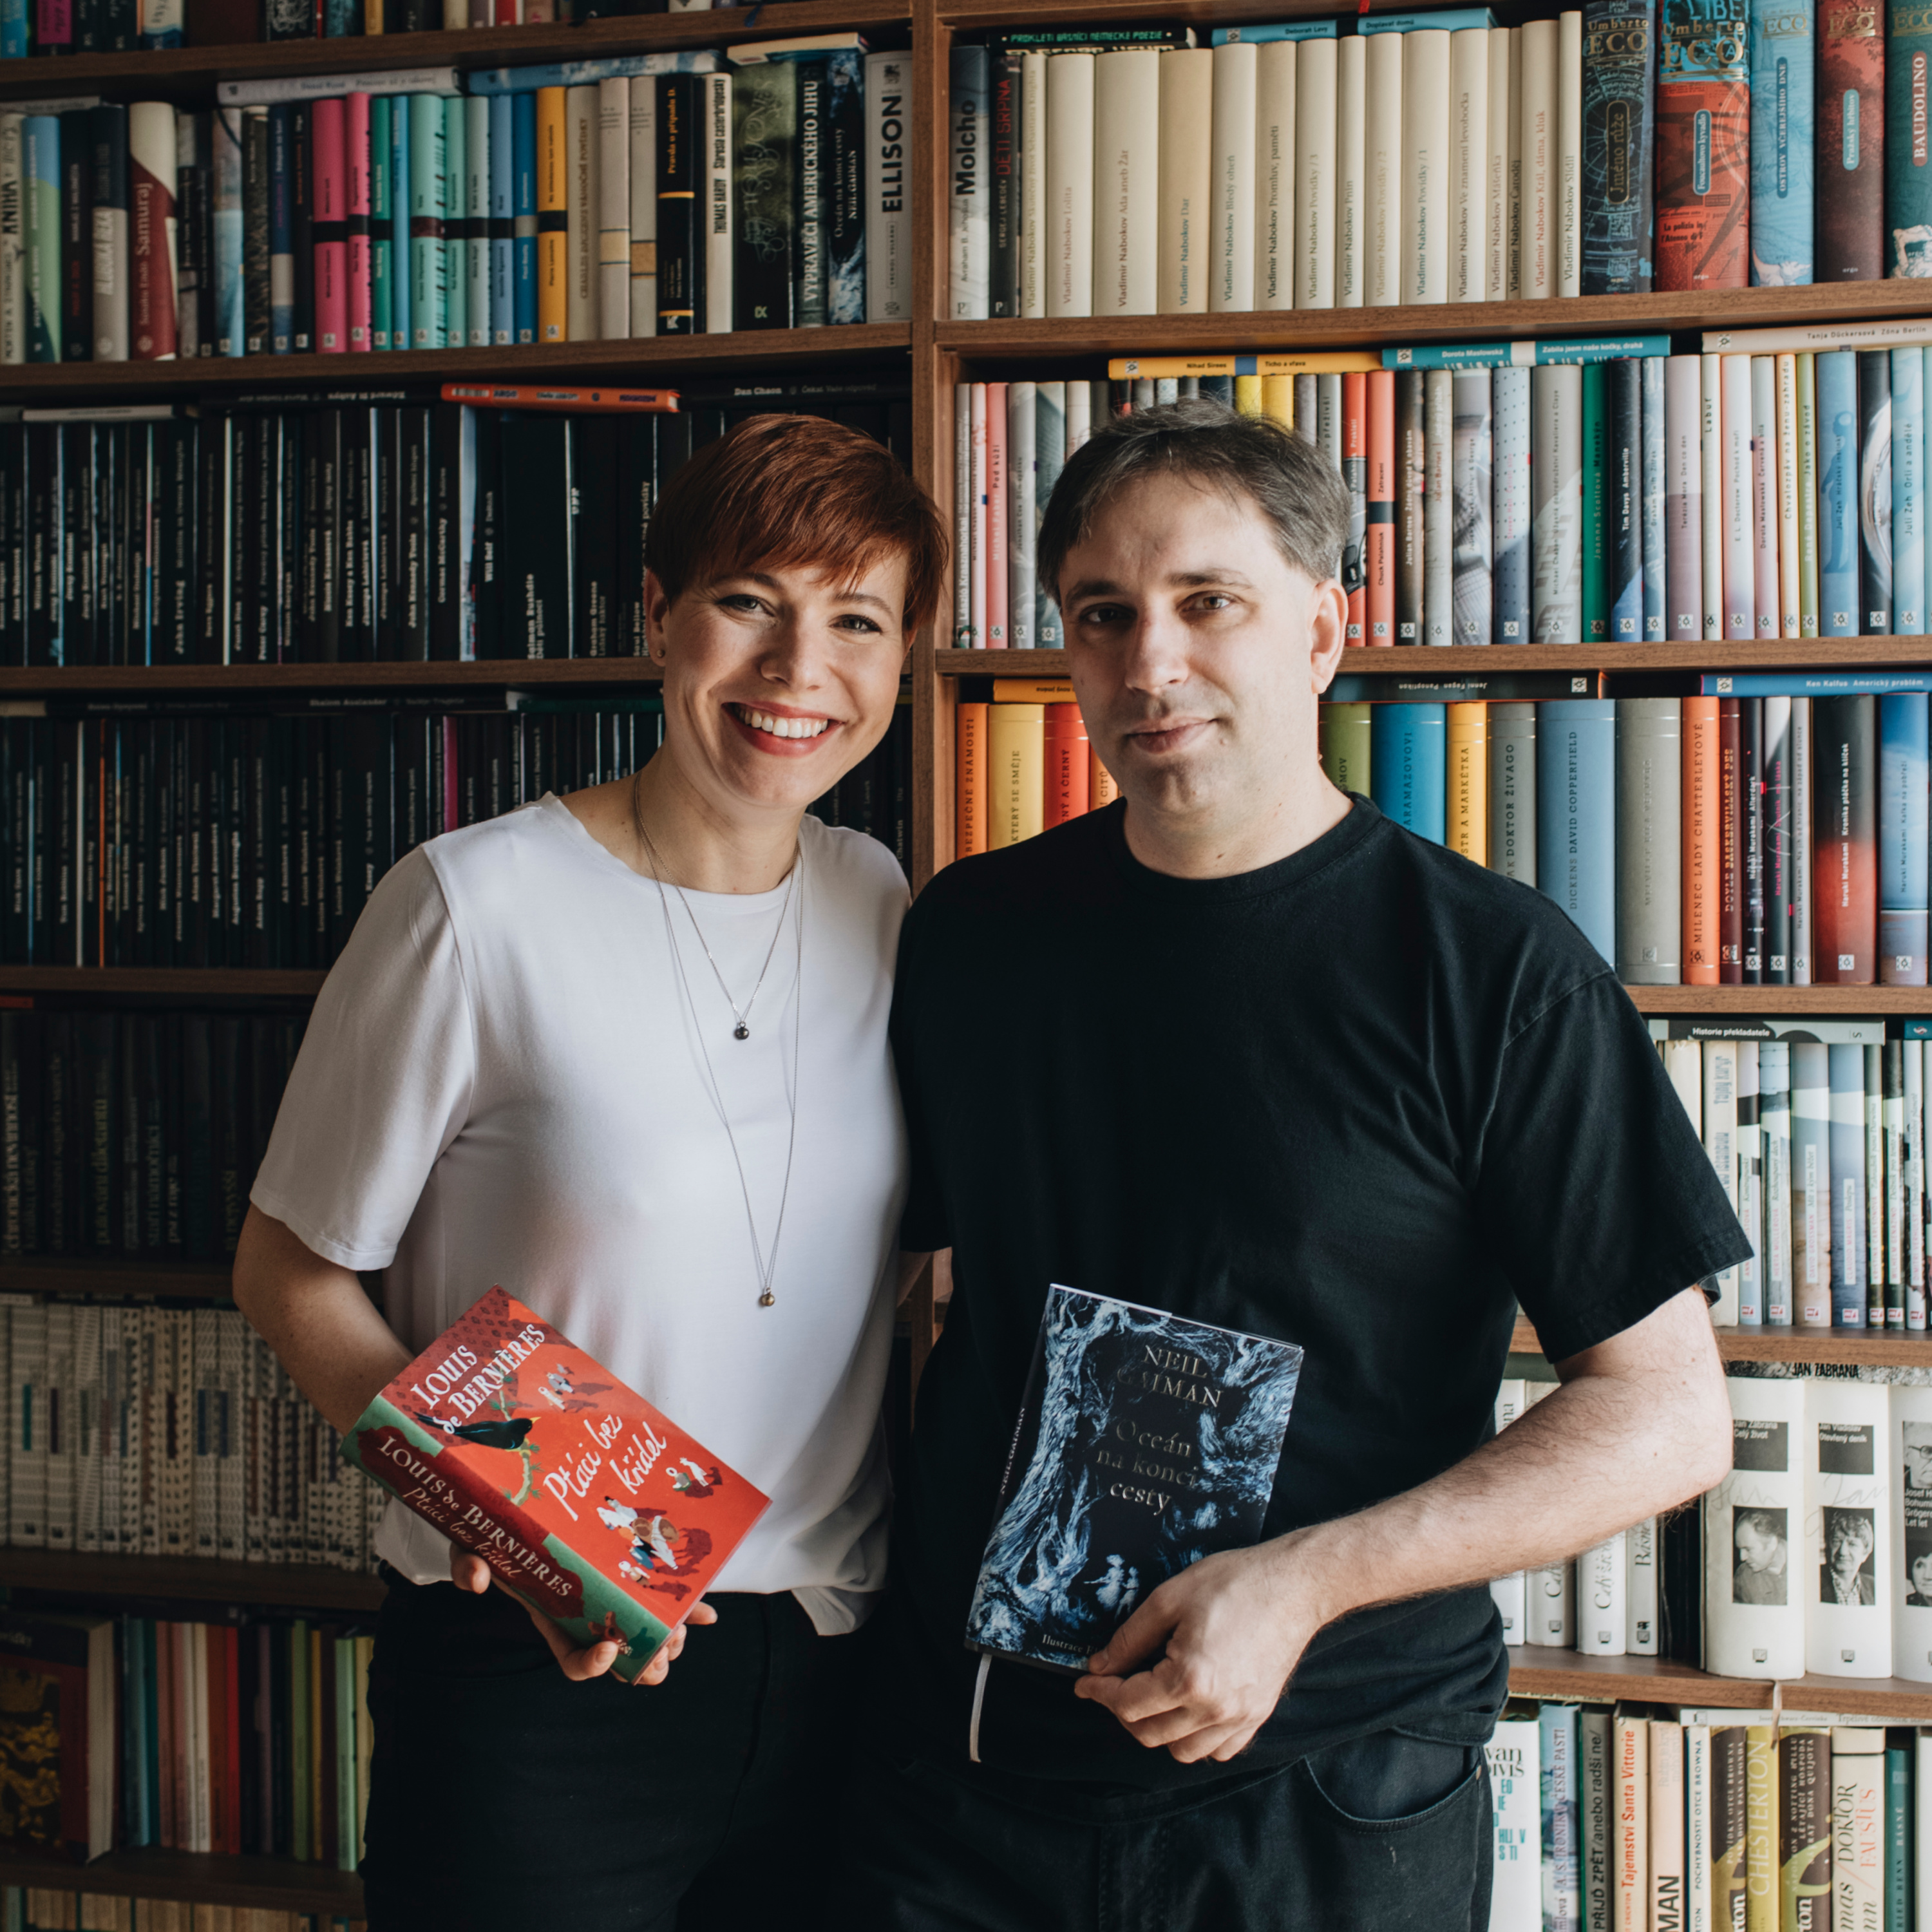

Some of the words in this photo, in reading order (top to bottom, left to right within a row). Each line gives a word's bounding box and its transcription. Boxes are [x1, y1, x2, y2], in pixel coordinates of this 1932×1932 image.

[1588, 18, 1649, 32] Umberto
[1663, 20, 1745, 36] Umberto
[1763, 16, 1807, 32] ECO
[1829, 14, 1874, 31] ECO
[1587, 31, 1647, 55] ECO
[1663, 37, 1744, 68] ECO
[1779, 64, 1787, 84] DNE
[667, 99, 678, 133] případu
[804, 80, 818, 116] JIHU
[997, 79, 1010, 133] SRPNA
[1846, 94, 1855, 126] hřbitov
[1913, 56, 1925, 158] BAUDOLINO
[1535, 110, 1545, 133] kluk
[1610, 113, 1625, 142] růže
[1698, 114, 1709, 143] kyvadlo
[1777, 88, 1787, 148] VČEREJŠÍHO
[835, 129, 845, 154] cesty
[882, 95, 902, 213] ELLISON
[956, 99, 976, 195] Molcho
[996, 140, 1010, 175] DĚTI
[1117, 149, 1129, 165] Žár
[1269, 126, 1281, 159] paměti
[1846, 128, 1855, 164] Pražský
[801, 119, 818, 218] AMERICKÉHO
[834, 158, 843, 185] konci
[848, 150, 857, 192] GAIMAN
[1119, 169, 1128, 192] aneb
[1226, 155, 1236, 180] oheň
[1459, 146, 1469, 189] znamení
[1610, 147, 1625, 193] Jméno
[1698, 144, 1706, 189] Foucaultovo
[1779, 154, 1787, 191] OSTROV
[714, 178, 726, 202] HARDY
[837, 189, 843, 200] na
[848, 194, 857, 219] NEIL
[1063, 187, 1072, 214] Lolita
[1120, 196, 1129, 214] Ada
[1180, 198, 1189, 215] Dar
[1226, 184, 1236, 209] Bledý
[1459, 193, 1468, 204] Ve
[135, 183, 153, 256] Samuraj
[714, 204, 726, 234] THOMAS
[834, 204, 843, 238] Oceán
[1225, 213, 1234, 256] Nabokov
[1268, 210, 1278, 253] Nabokov
[1345, 207, 1354, 251] Nabokov
[1459, 207, 1468, 251] Nabokov
[1535, 196, 1545, 241] Nabokov
[1063, 218, 1072, 260] Nabokov
[1119, 218, 1128, 261] Nabokov
[1180, 220, 1189, 261] Nabokov
[801, 222, 818, 301] VYPRAVĚČI
[1268, 257, 1278, 298] Vladimir
[1345, 254, 1354, 296] Vladimir
[1459, 255, 1468, 296] Vladimir
[1535, 244, 1545, 287] Vladimir
[1063, 263, 1072, 303] Vladimir
[1118, 265, 1128, 307] Vladimir
[1180, 265, 1189, 305] Vladimir
[1225, 260, 1234, 301] Vladimir
[1904, 469, 1913, 488] Orli
[1904, 496, 1913, 513] Zeh
[1904, 517, 1913, 535] Juli
[1853, 679, 1889, 687] Americký
[1891, 678, 1923, 687] problém
[965, 719, 974, 782] ZNÁMOSTI
[1010, 750, 1021, 784] SMĚJE
[1504, 744, 1514, 796] ŽIVAGO
[1692, 723, 1703, 836] CHATTERLEYOVÉ
[1842, 768, 1849, 777] na
[1011, 790, 1019, 802] SE
[1841, 780, 1850, 804] ptáčka
[964, 789, 973, 853] BEZPEČNÉ
[1010, 807, 1019, 842] KTERÝ
[1506, 803, 1514, 857] DOKTOR
[1694, 843, 1702, 876] LADY
[1694, 884, 1702, 943] MILENEC
[1692, 1027, 1722, 1036] Historie
[1724, 1028, 1770, 1037] překladatele
[410, 1344, 478, 1409] LOUIS
[432, 1416, 462, 1435] de
[447, 1323, 546, 1419] BERNIÈRES
[1141, 1344, 1208, 1379] NEIL
[1792, 1362, 1812, 1376] JAN
[1117, 1367, 1222, 1408] GAIMAN
[1115, 1419, 1193, 1459] Oceán
[542, 1441, 602, 1522] Ptáci
[583, 1412, 623, 1453] bez
[609, 1421, 667, 1495] křídel
[1096, 1445, 1124, 1466] na
[1133, 1452, 1201, 1490] konci
[379, 1436, 444, 1496] LOUIS
[442, 1481, 461, 1511] de
[461, 1501, 573, 1598] BERNIÈRES
[402, 1486, 448, 1525] Ptáci
[451, 1519, 474, 1544] bez
[1109, 1481, 1172, 1517] cesty
[1041, 1634, 1084, 1654] Ilustrace
[1620, 1730, 1635, 1779] Vittorie
[1727, 1742, 1735, 1784] BROWNA
[1589, 1757, 1604, 1792] radši
[1621, 1785, 1635, 1821] Santa
[1727, 1788, 1735, 1815] OTCE
[1747, 1741, 1769, 1895] CHESTERTON
[1834, 1783, 1857, 1861] DOKTOR
[1855, 1788, 1877, 1867] FAUSTUS
[1591, 1847, 1605, 1884] ZPĚT
[1591, 1889, 1605, 1929] PŘIJĎ
